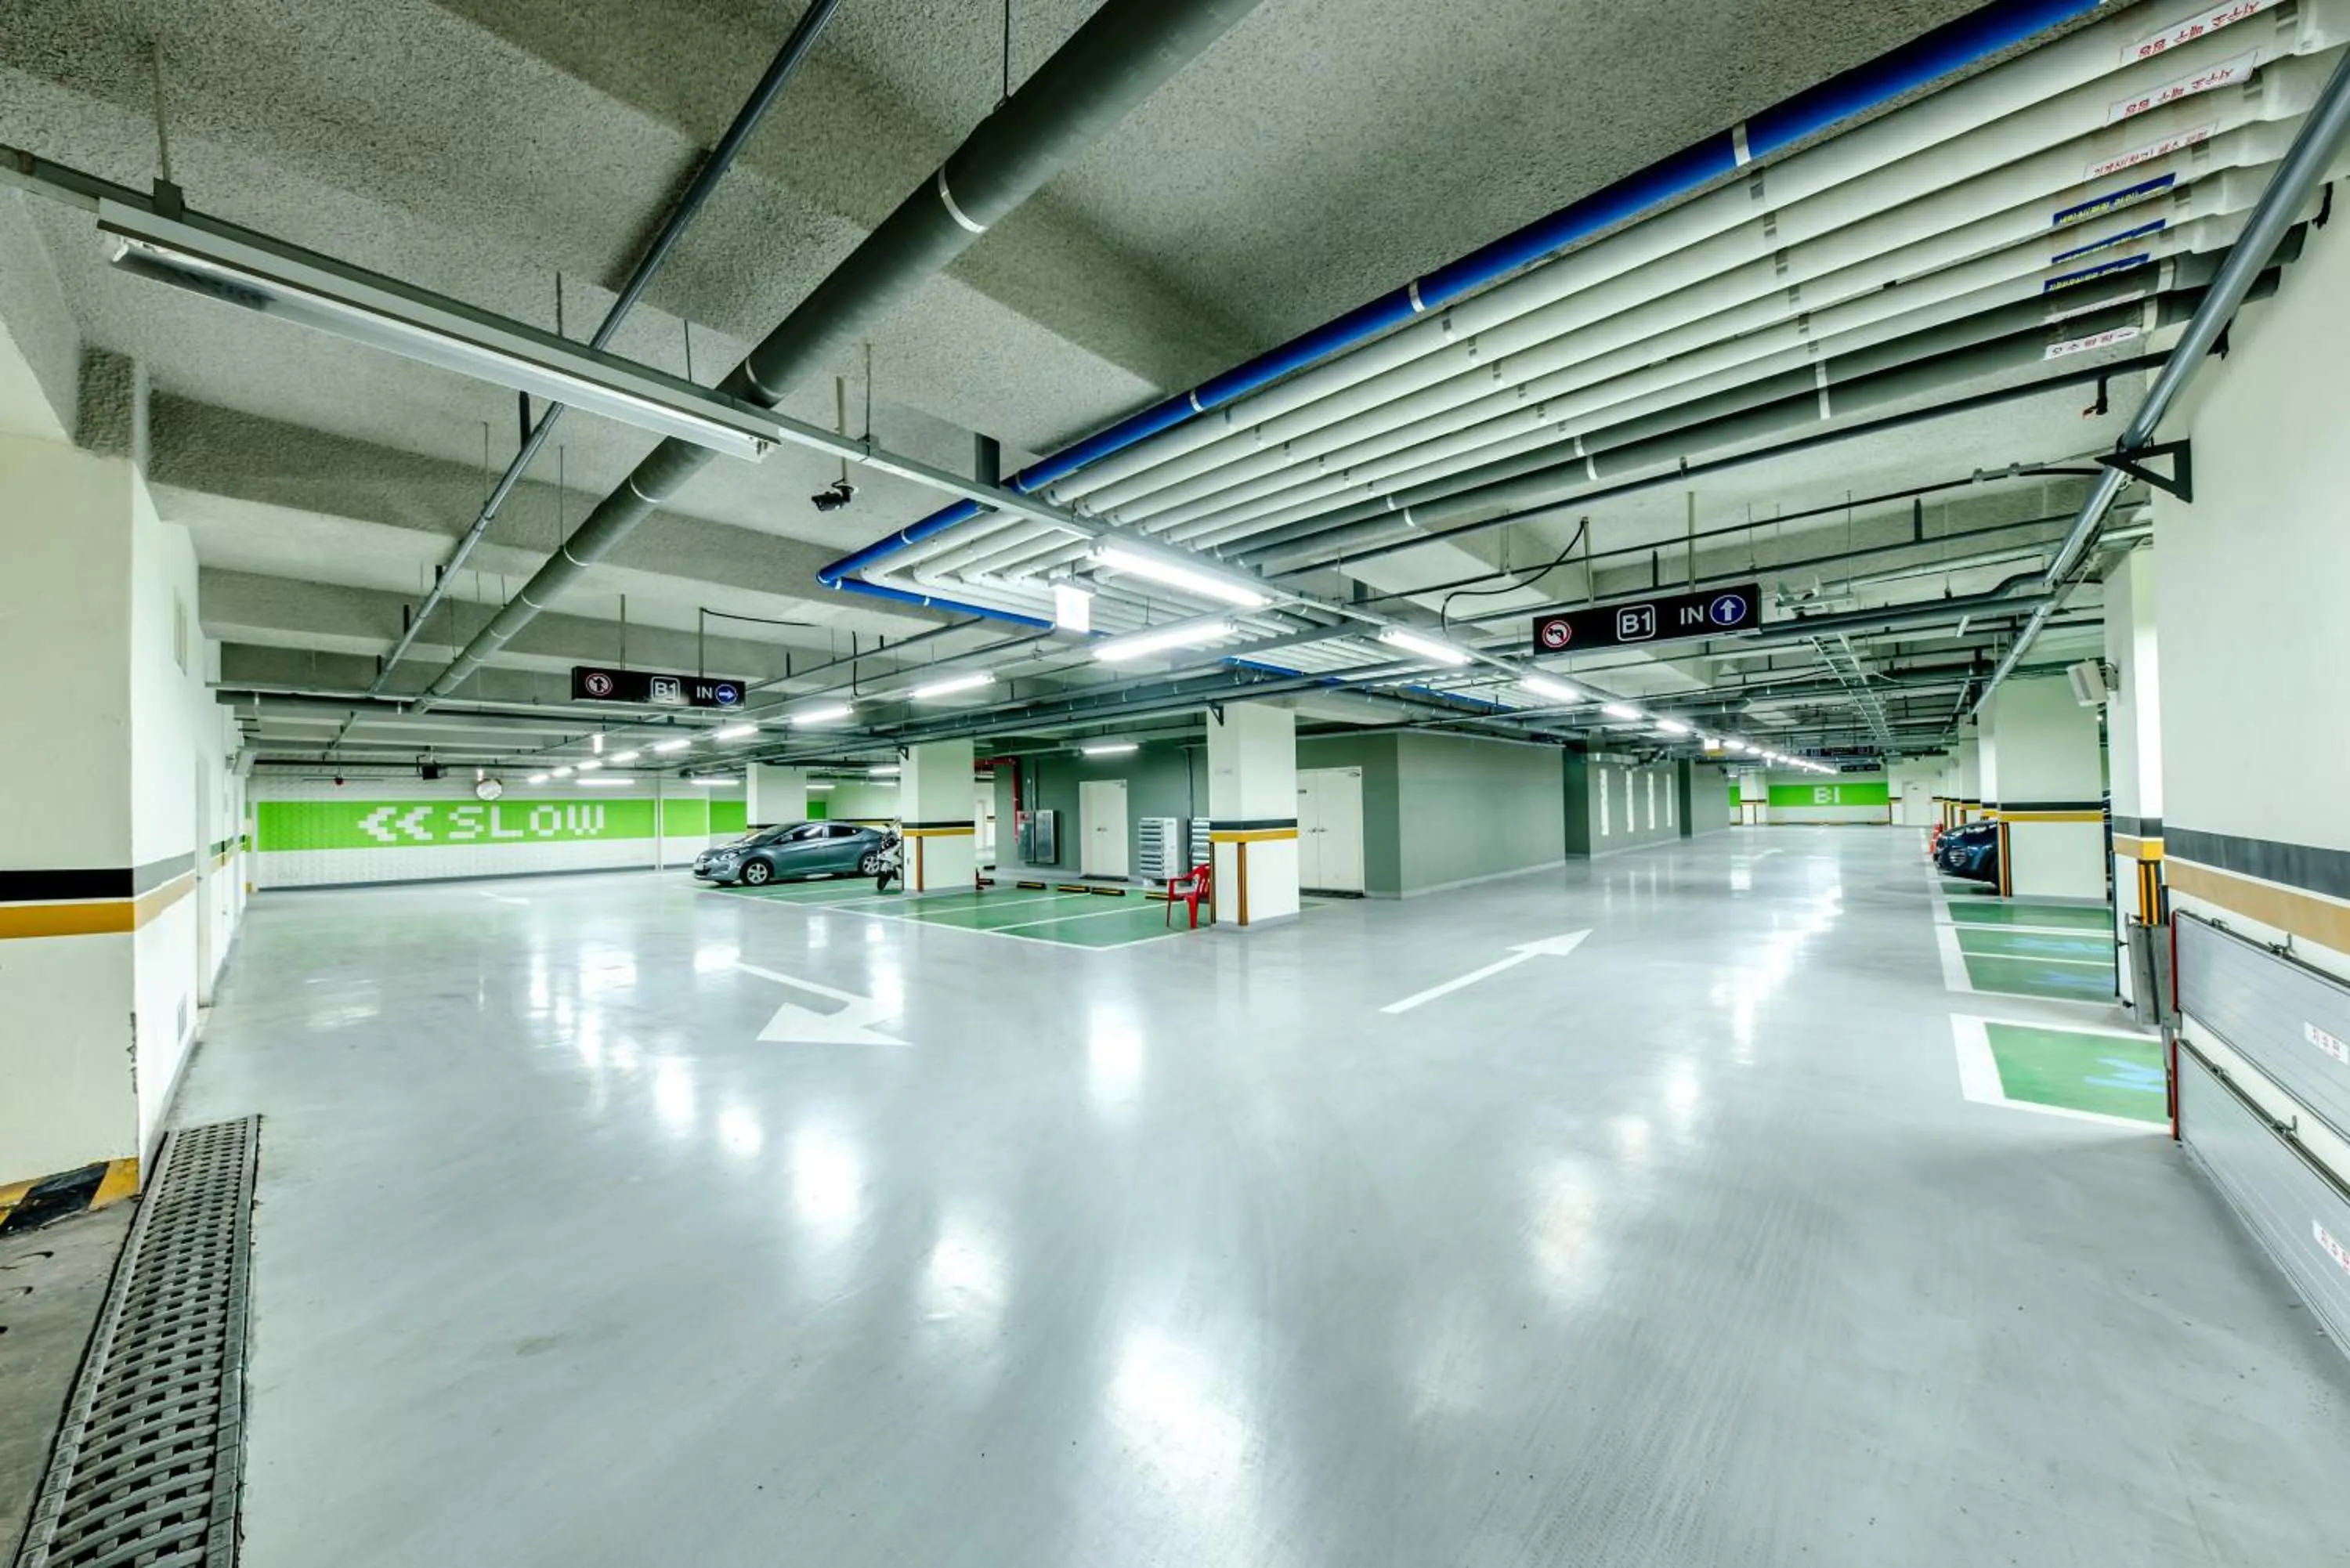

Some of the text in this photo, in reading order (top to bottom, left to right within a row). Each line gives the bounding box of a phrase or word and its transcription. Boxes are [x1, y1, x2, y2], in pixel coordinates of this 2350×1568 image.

[1622, 605, 1704, 634] B1 IN
[654, 681, 713, 700] B1 IN
[449, 805, 605, 840] SLOW
